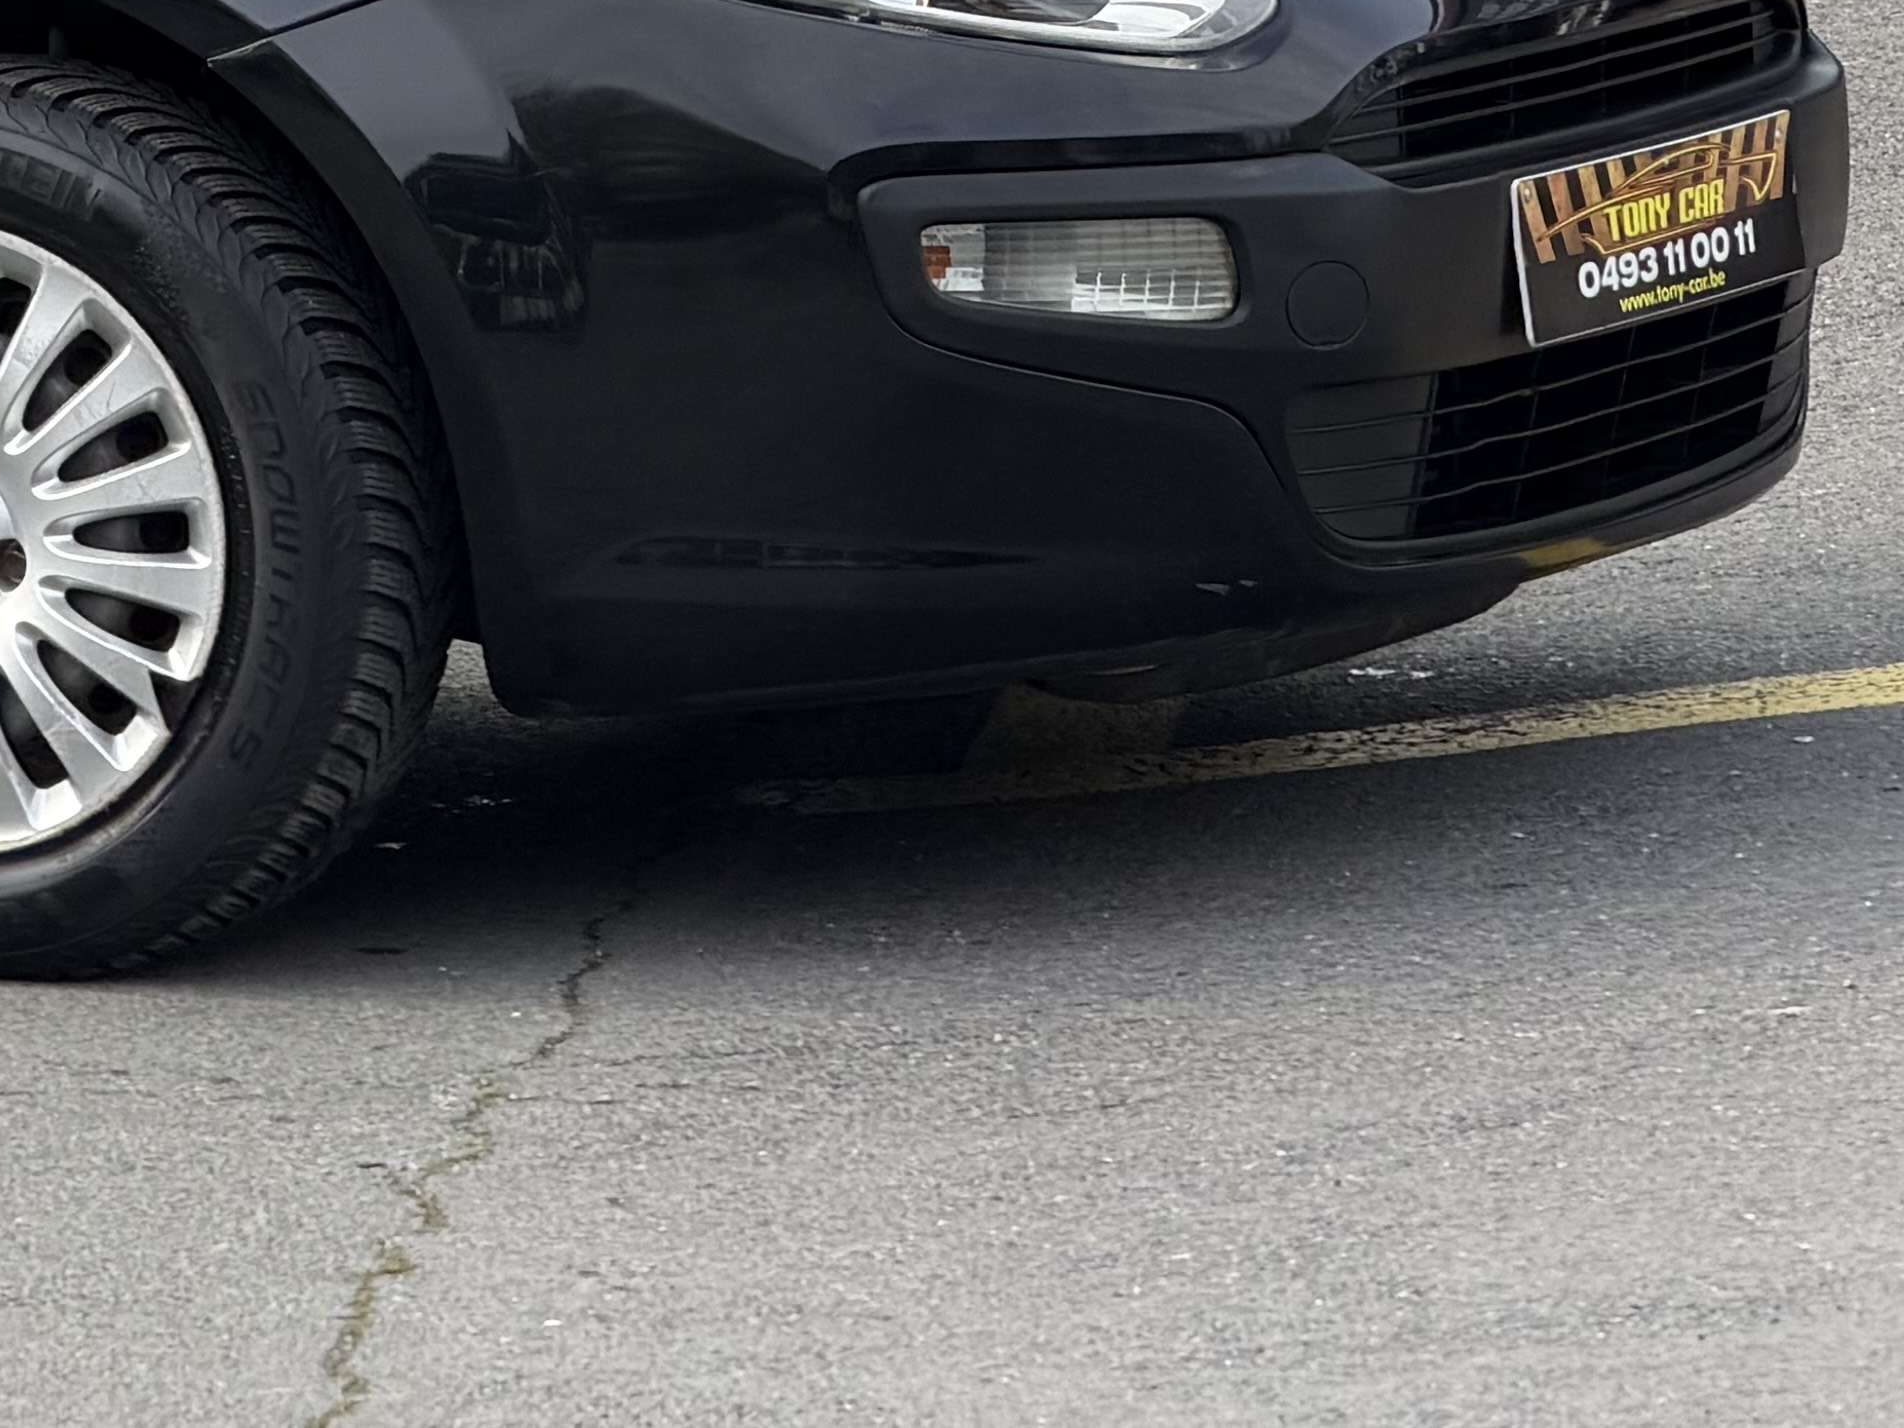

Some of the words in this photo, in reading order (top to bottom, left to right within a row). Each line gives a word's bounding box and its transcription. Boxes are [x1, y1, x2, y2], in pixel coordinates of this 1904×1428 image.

[1603, 192, 1671, 242] TONY
[1679, 178, 1727, 224] CAR
[1578, 245, 1659, 298] 0493
[1663, 238, 1686, 276] 11
[1690, 227, 1730, 263] 00
[1734, 218, 1756, 256] 11
[1619, 268, 1727, 314] www.tony-car.be
